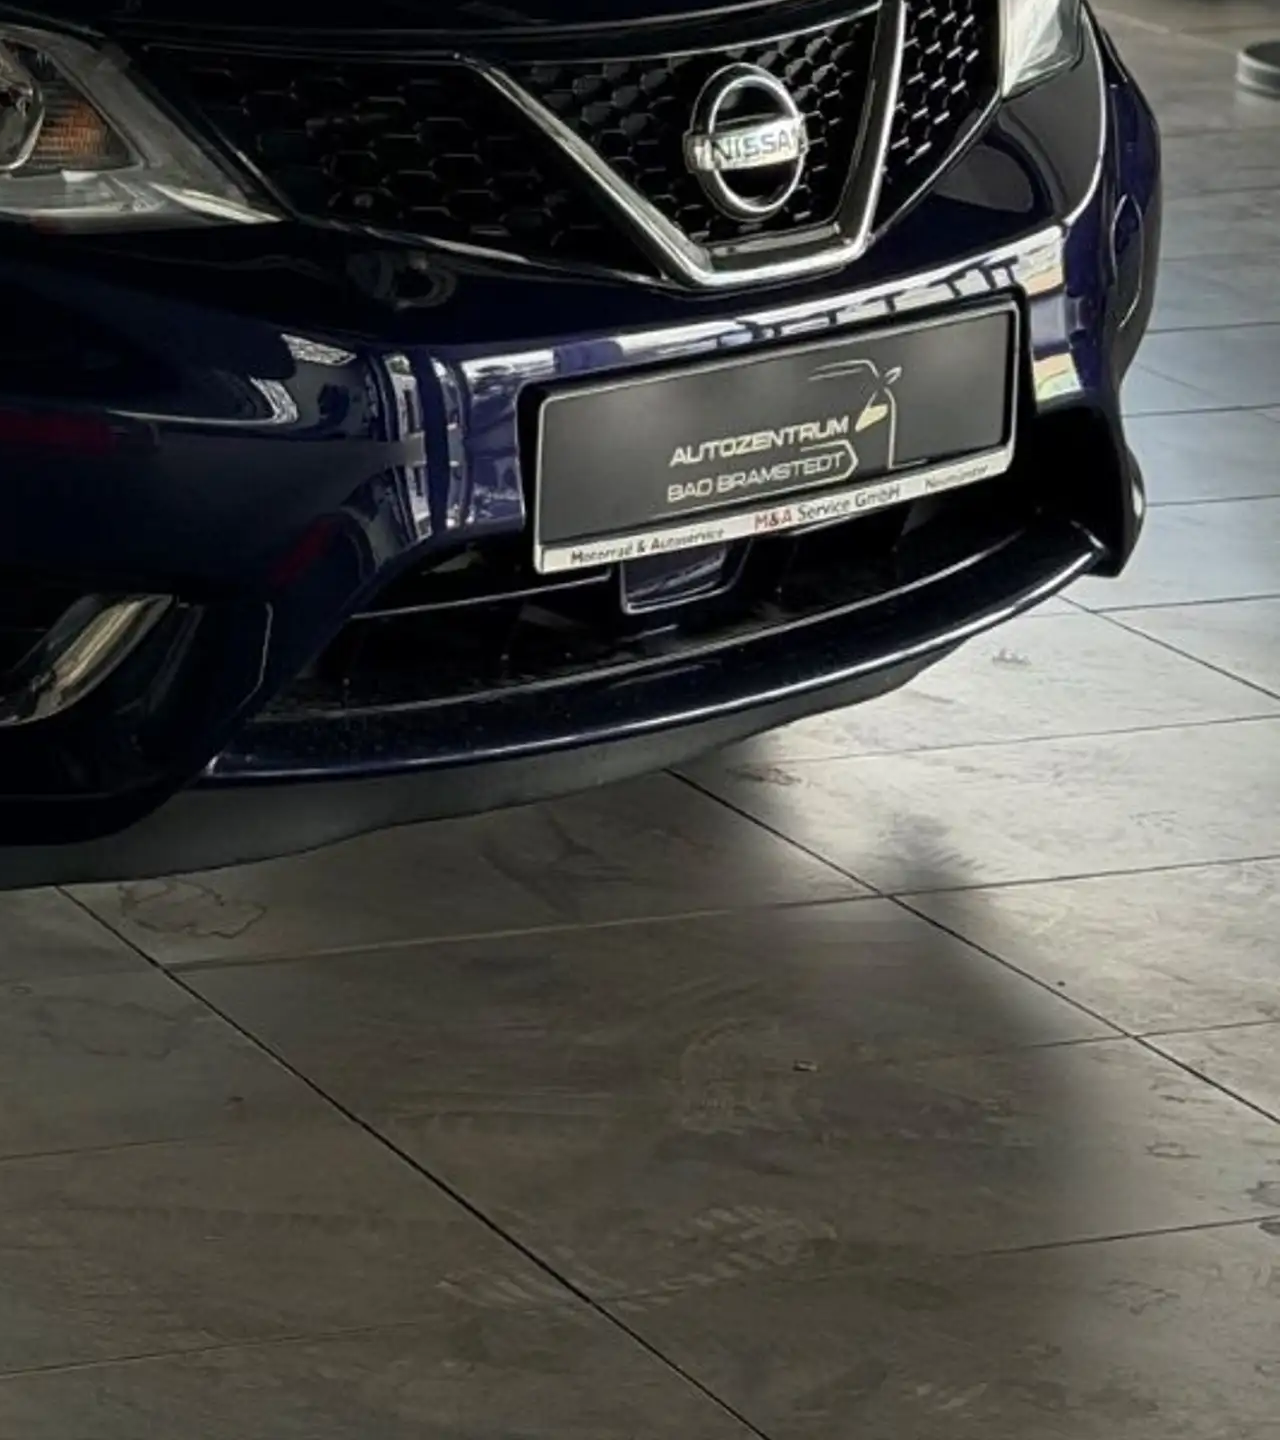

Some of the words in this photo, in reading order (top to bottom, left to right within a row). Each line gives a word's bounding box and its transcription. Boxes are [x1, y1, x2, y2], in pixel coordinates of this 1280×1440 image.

[668, 415, 850, 468] AUTOZENTRUM
[666, 477, 713, 504] BAD
[716, 451, 846, 493] BRAMSTEDT
[569, 542, 632, 565] Motorrad
[649, 527, 725, 551] Autoservice
[753, 507, 794, 532] M&A
[797, 498, 851, 522] Service
[854, 484, 902, 509] GmbH
